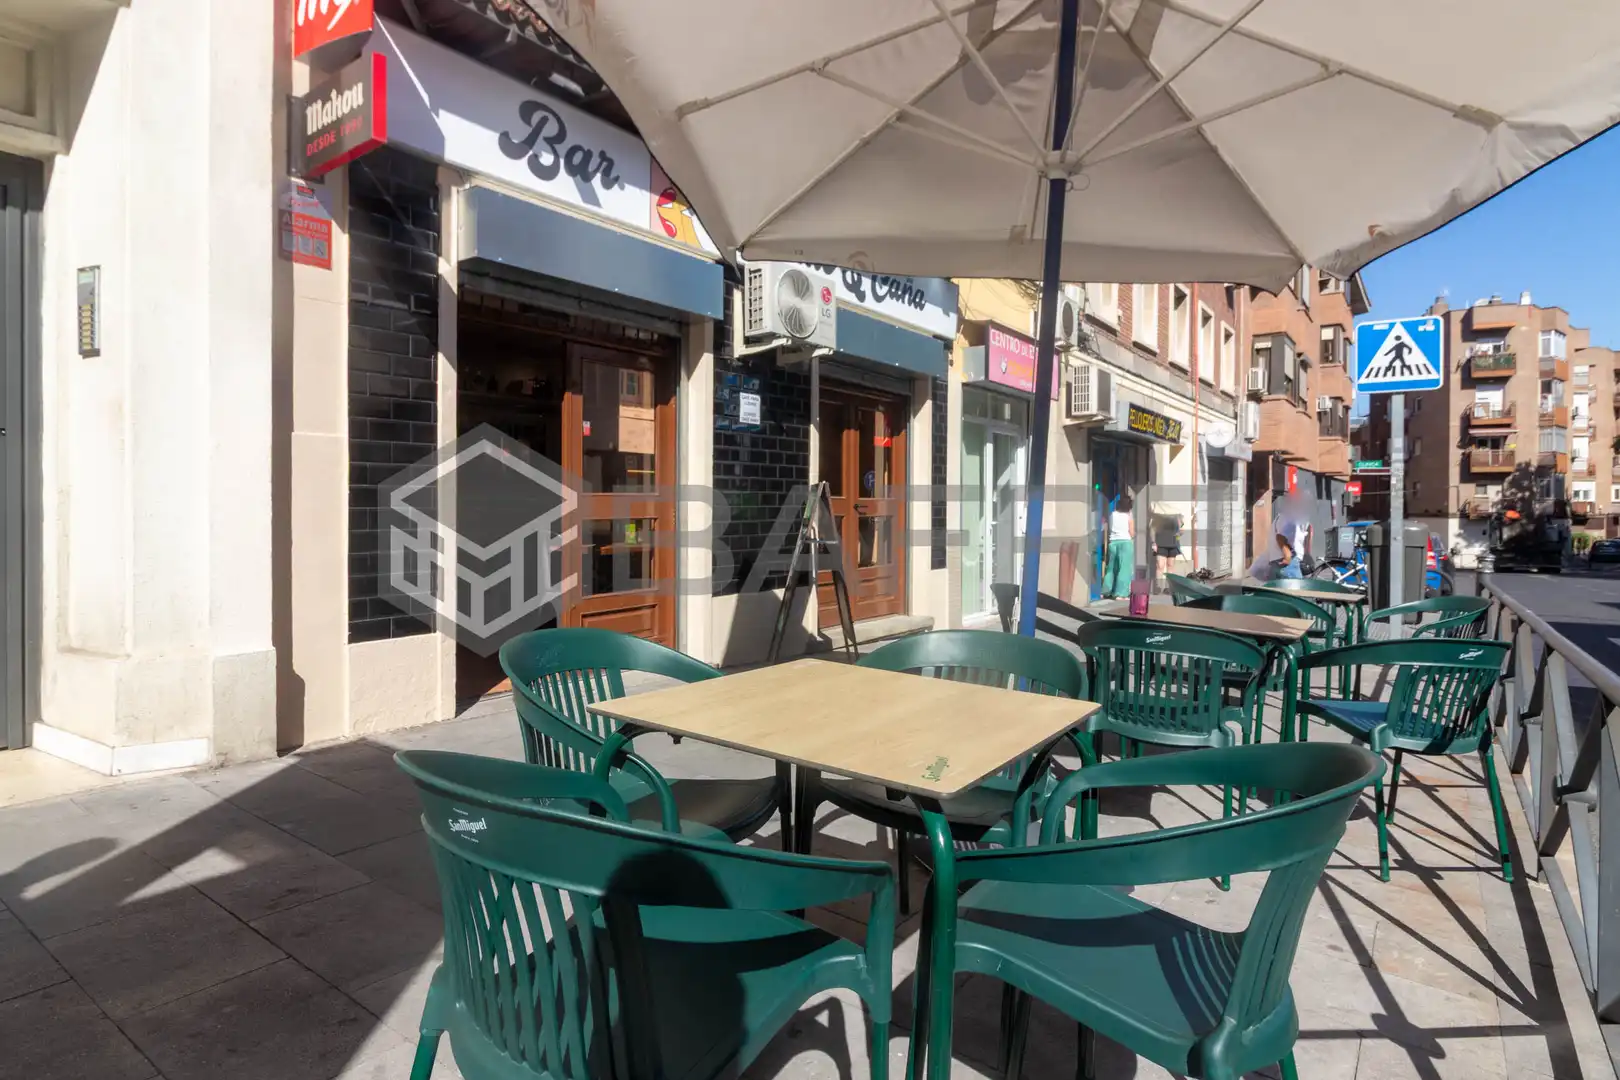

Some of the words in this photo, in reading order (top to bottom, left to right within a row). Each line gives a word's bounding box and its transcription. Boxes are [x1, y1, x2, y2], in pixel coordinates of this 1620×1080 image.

[305, 82, 364, 135] Mahou
[306, 130, 337, 157] DESDE
[498, 99, 620, 191] Bar
[821, 308, 832, 318] LG
[991, 329, 1021, 354] CENTRO
